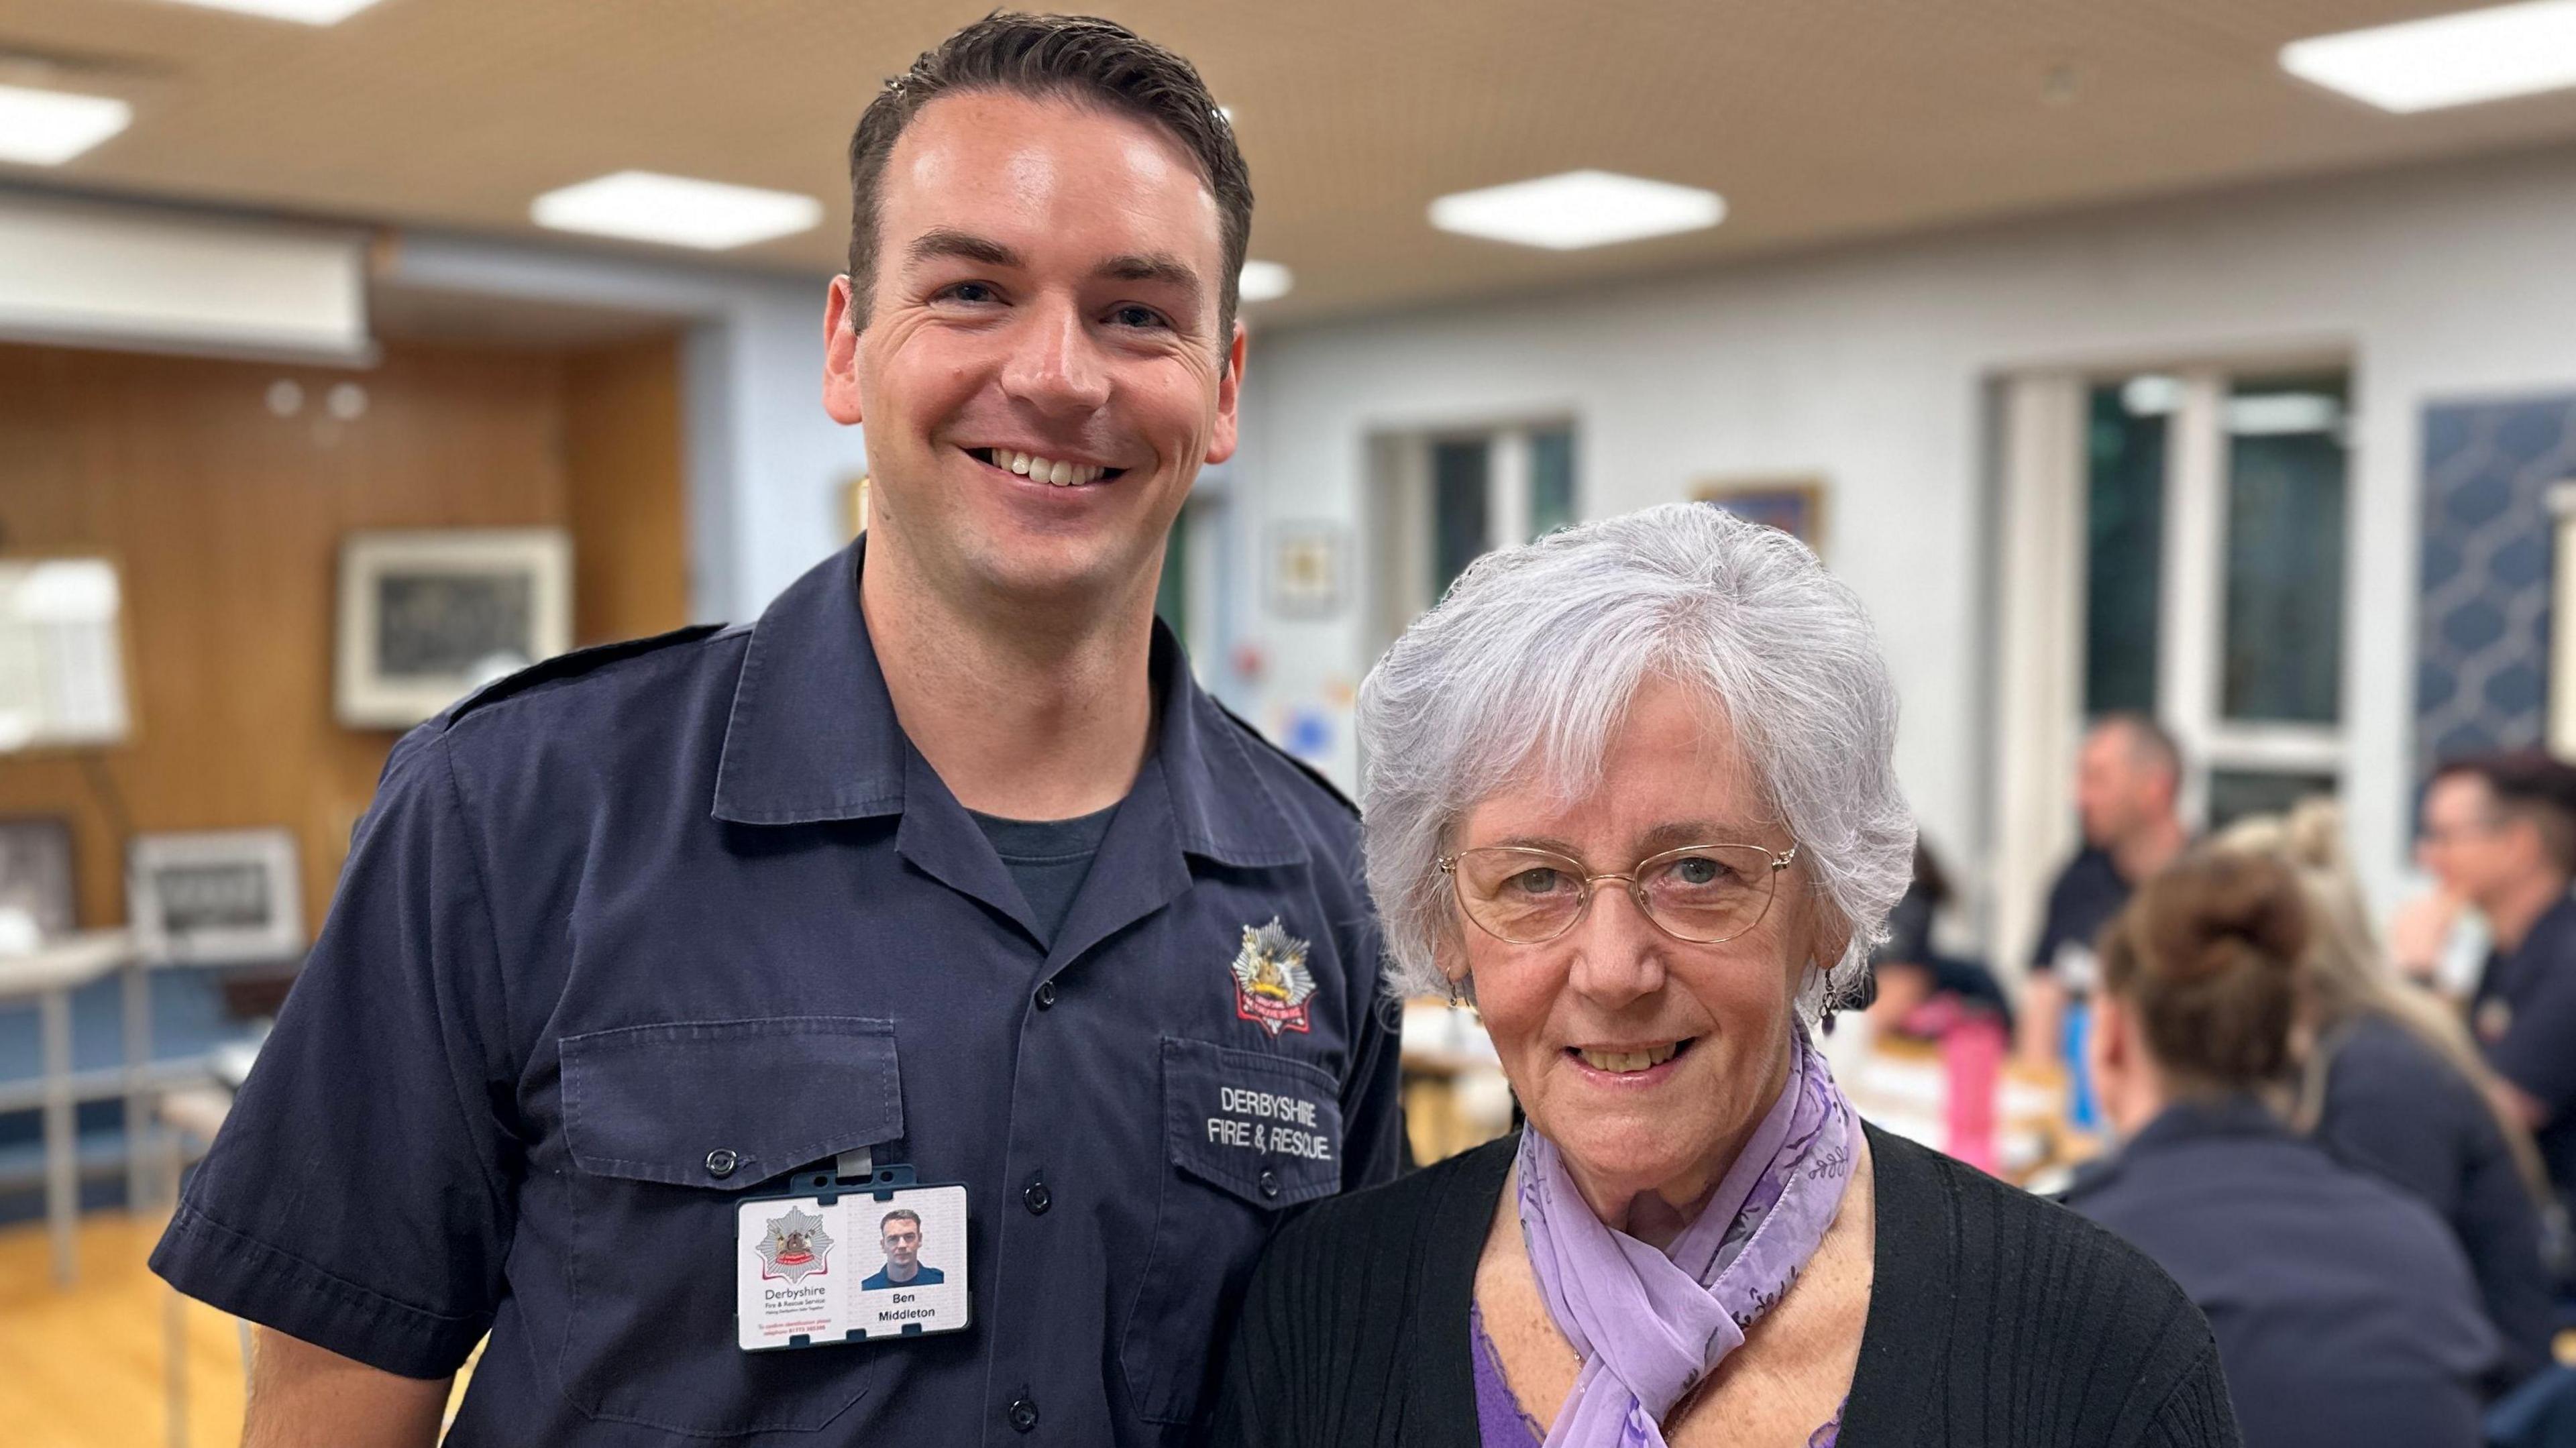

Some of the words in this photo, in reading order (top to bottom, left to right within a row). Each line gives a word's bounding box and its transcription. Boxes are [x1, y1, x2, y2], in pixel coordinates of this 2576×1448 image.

[1221, 1087, 1317, 1128] DERBYSHIRE
[1208, 1117, 1250, 1147] FIRE
[1270, 1127, 1332, 1160] RESCUE
[765, 1286, 825, 1300] Derbyshire
[893, 1294, 915, 1303] Ben
[879, 1308, 935, 1321] Middleton
